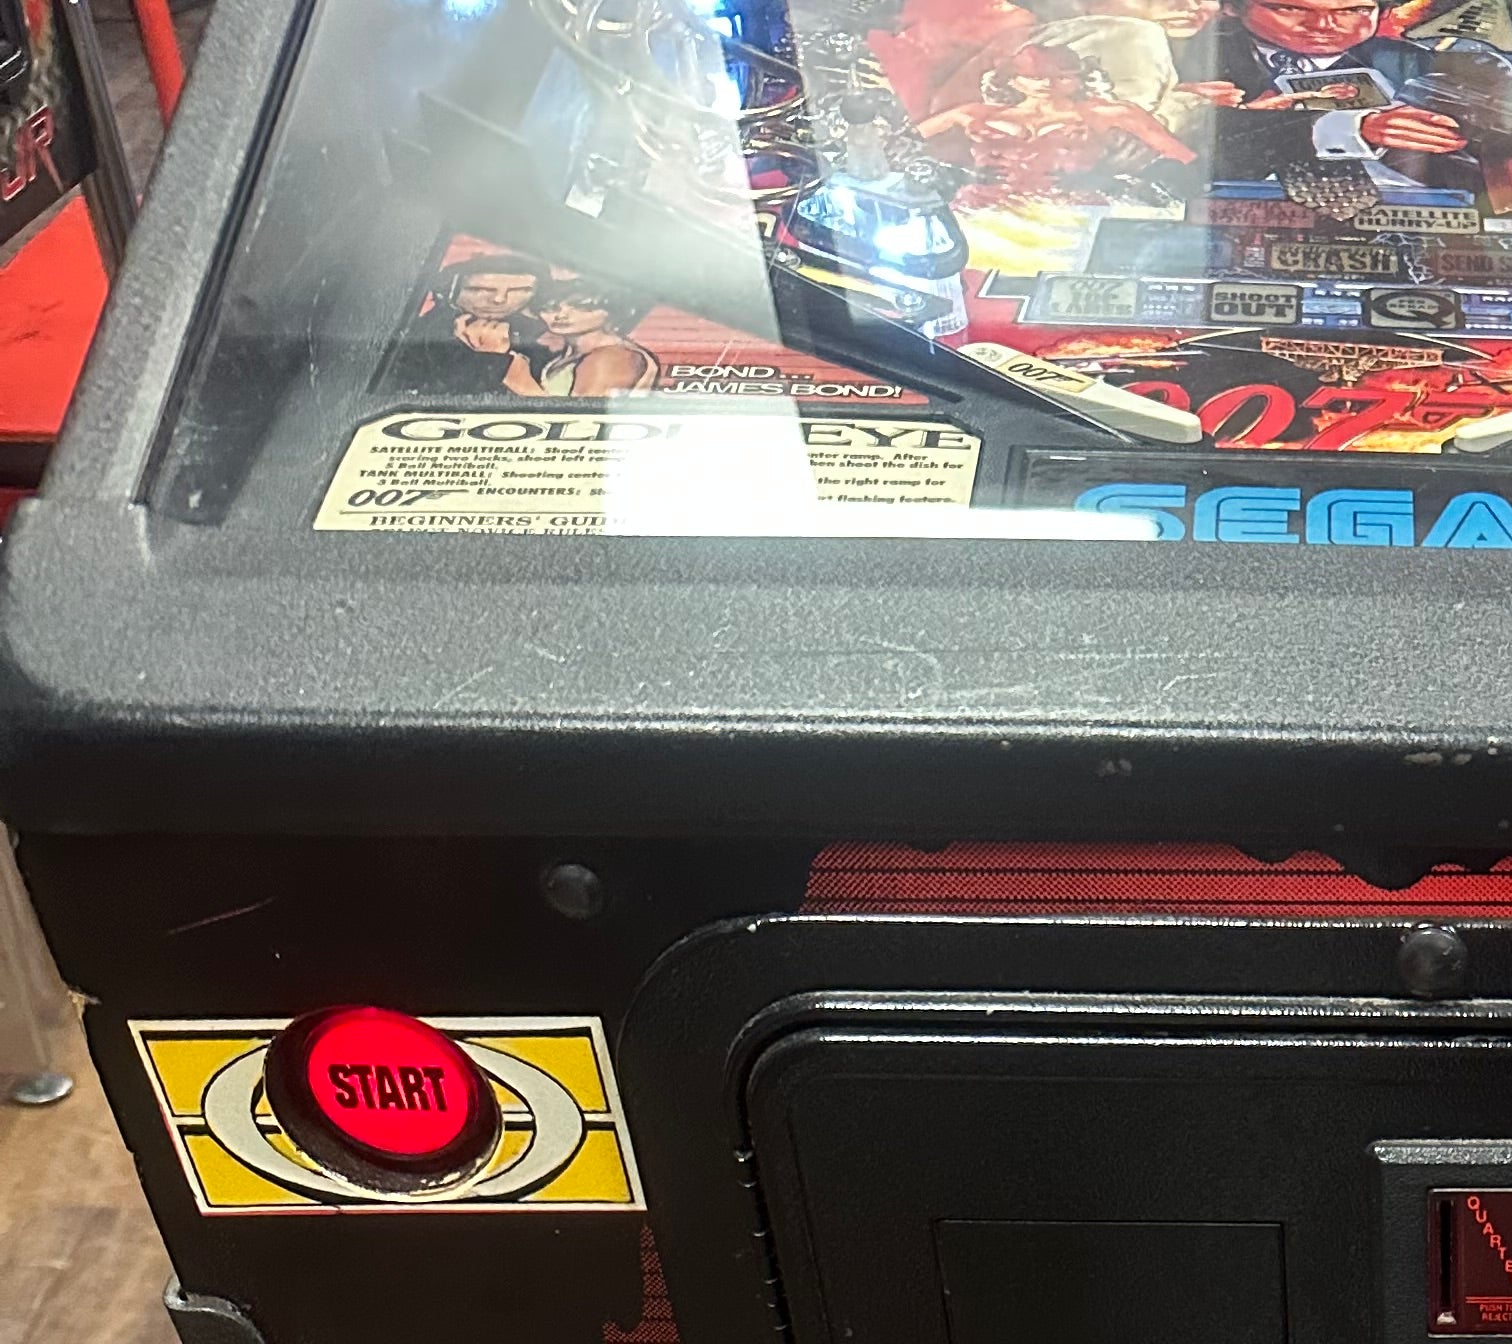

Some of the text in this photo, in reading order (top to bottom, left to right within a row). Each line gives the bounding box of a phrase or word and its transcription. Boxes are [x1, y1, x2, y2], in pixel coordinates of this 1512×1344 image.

[1357, 217, 1478, 231] HURRY-UP
[1441, 255, 1494, 273] SEND
[1214, 291, 1297, 304] SHOOT
[1213, 303, 1294, 318] OUT
[663, 382, 903, 398] JAMES BOND!
[327, 1063, 448, 1113] START
